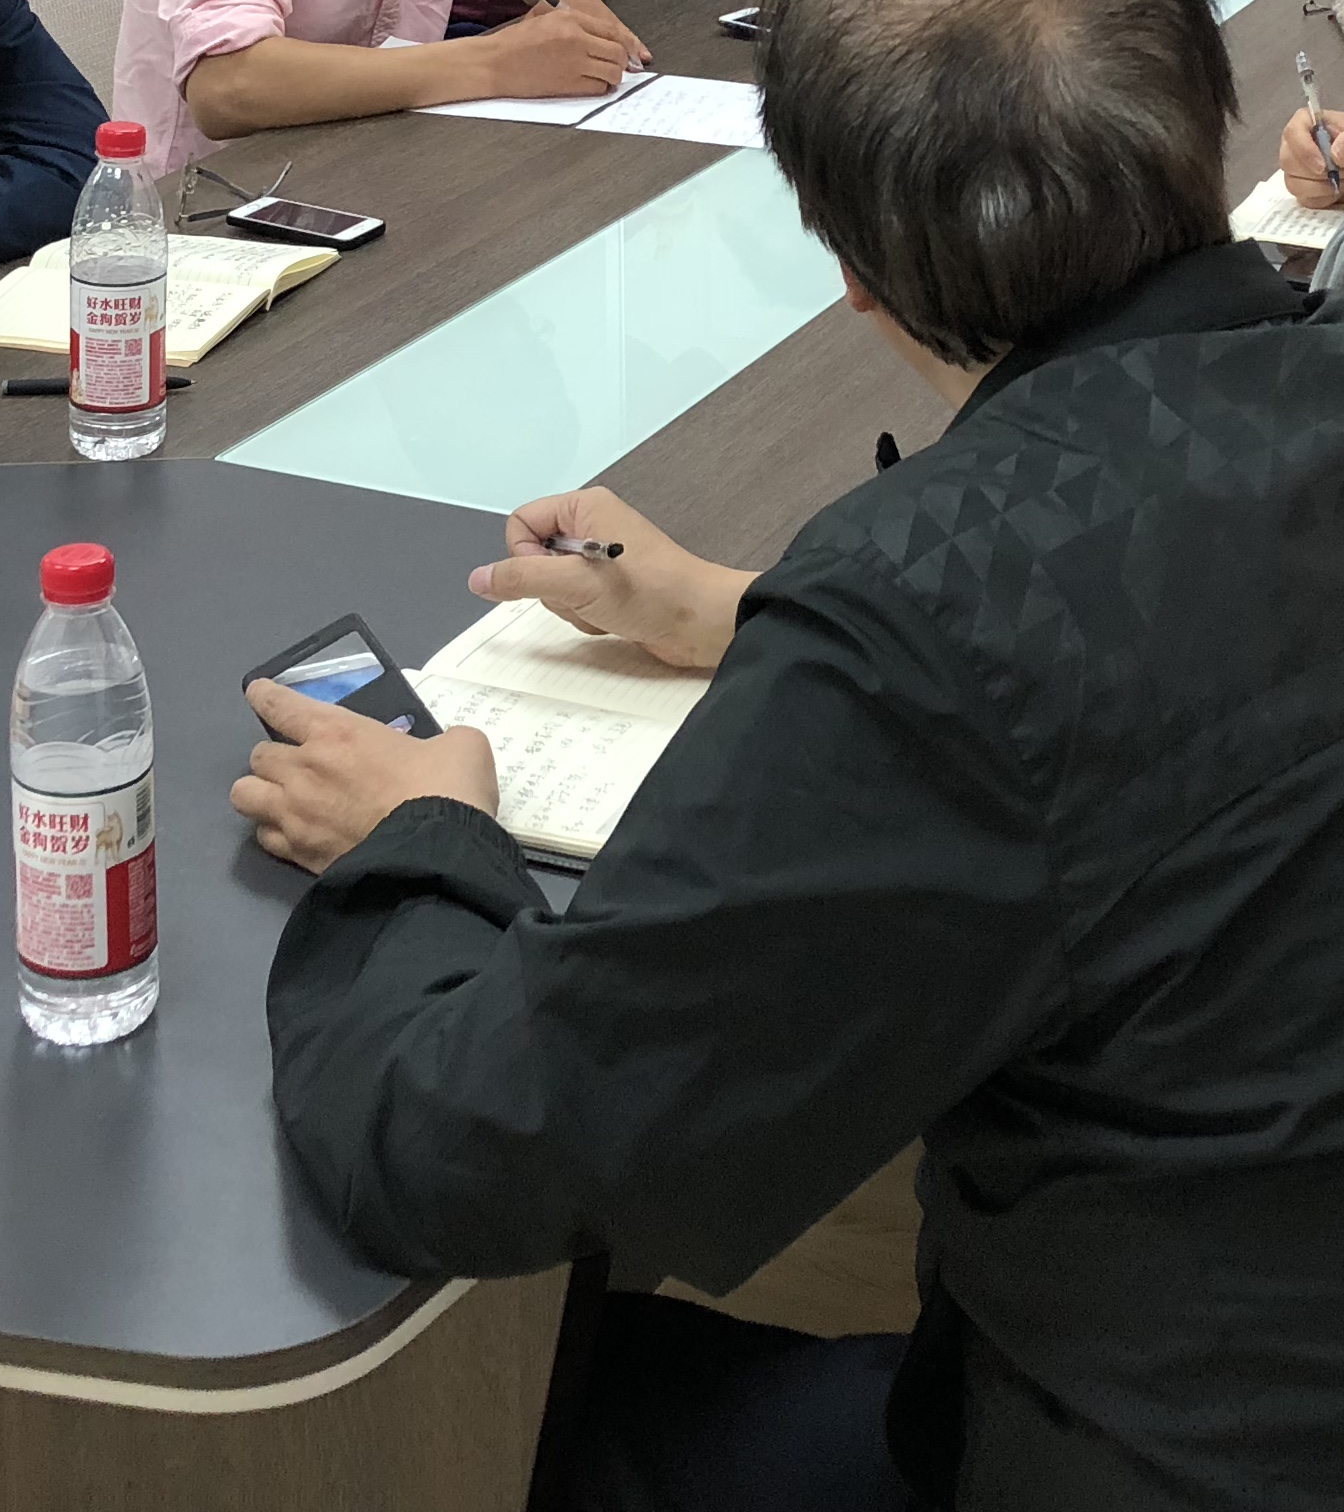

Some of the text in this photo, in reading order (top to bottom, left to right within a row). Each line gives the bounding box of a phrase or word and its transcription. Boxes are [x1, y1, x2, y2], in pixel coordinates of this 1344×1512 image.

[87, 295, 142, 311] 好水旺财
[87, 311, 142, 326] 金狗贺岁
[19, 802, 90, 834] 好水旺财
[19, 825, 90, 855] 金狗贺岁
